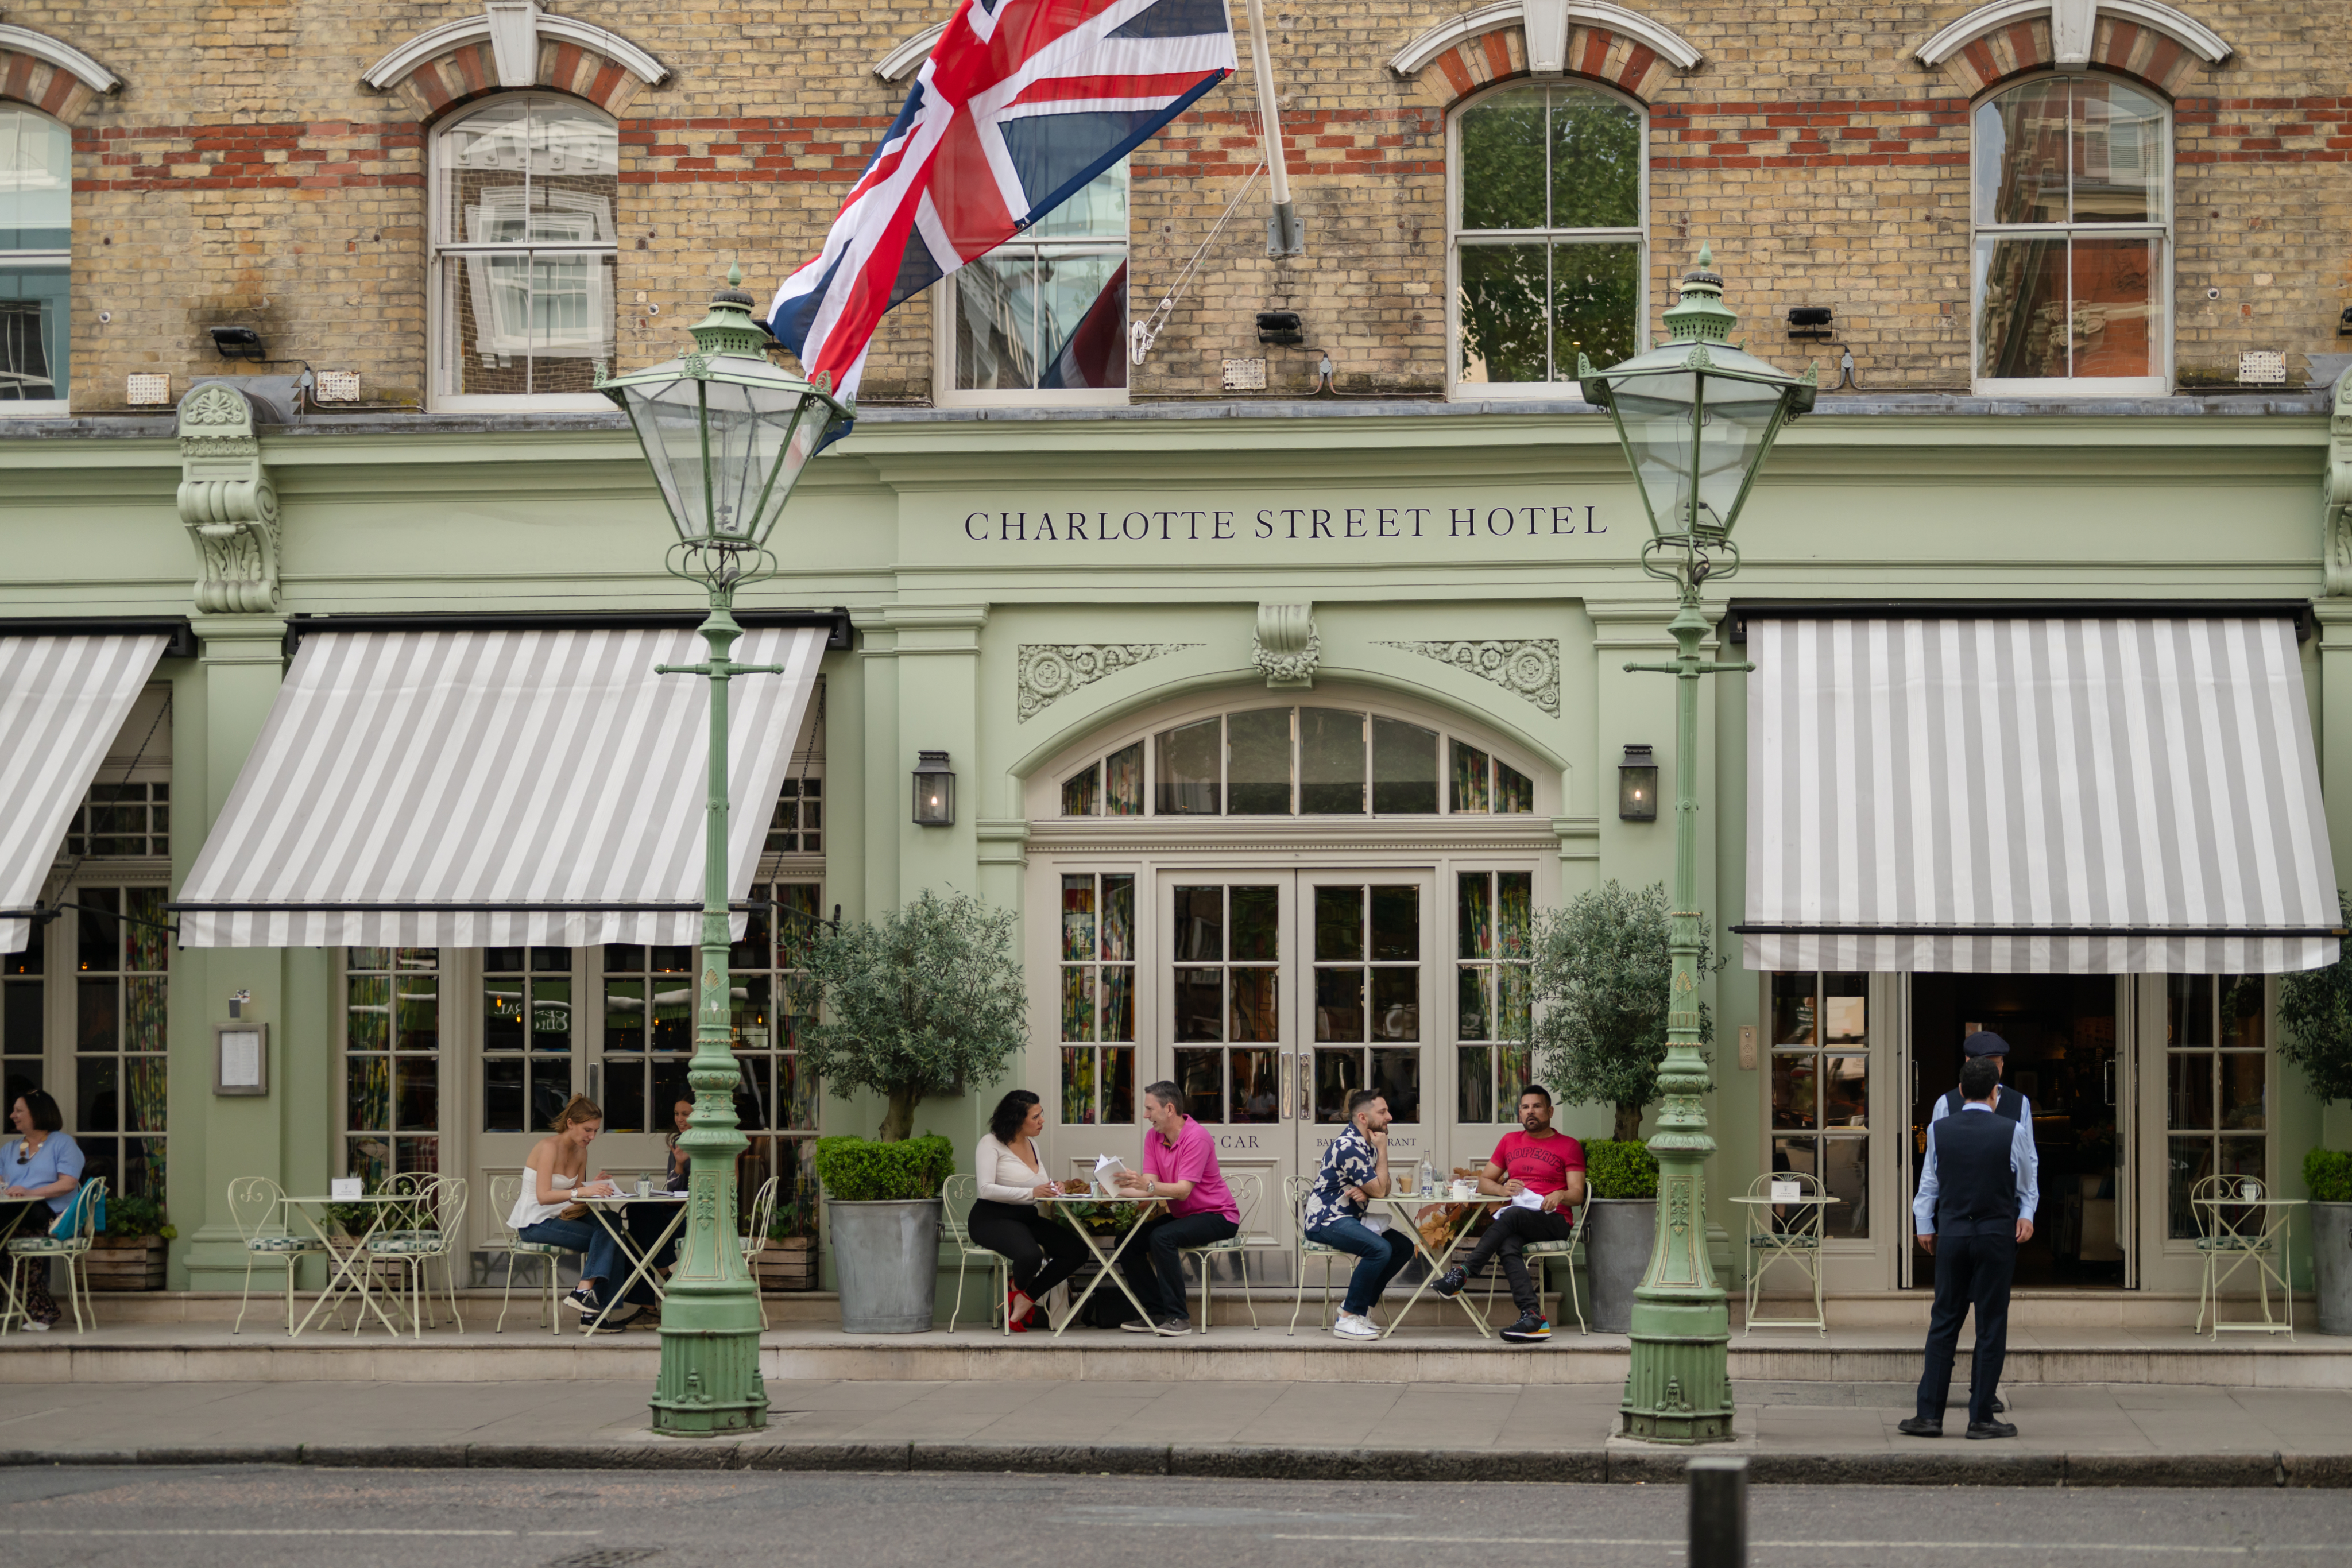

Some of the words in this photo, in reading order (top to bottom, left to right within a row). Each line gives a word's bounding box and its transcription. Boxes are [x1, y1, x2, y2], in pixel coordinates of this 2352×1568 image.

[964, 511, 1236, 540] CHARLOTTE
[1255, 509, 1431, 539] STREET
[1448, 506, 1608, 536] HOTEL
[1505, 1147, 1564, 1172] ROPERTY
